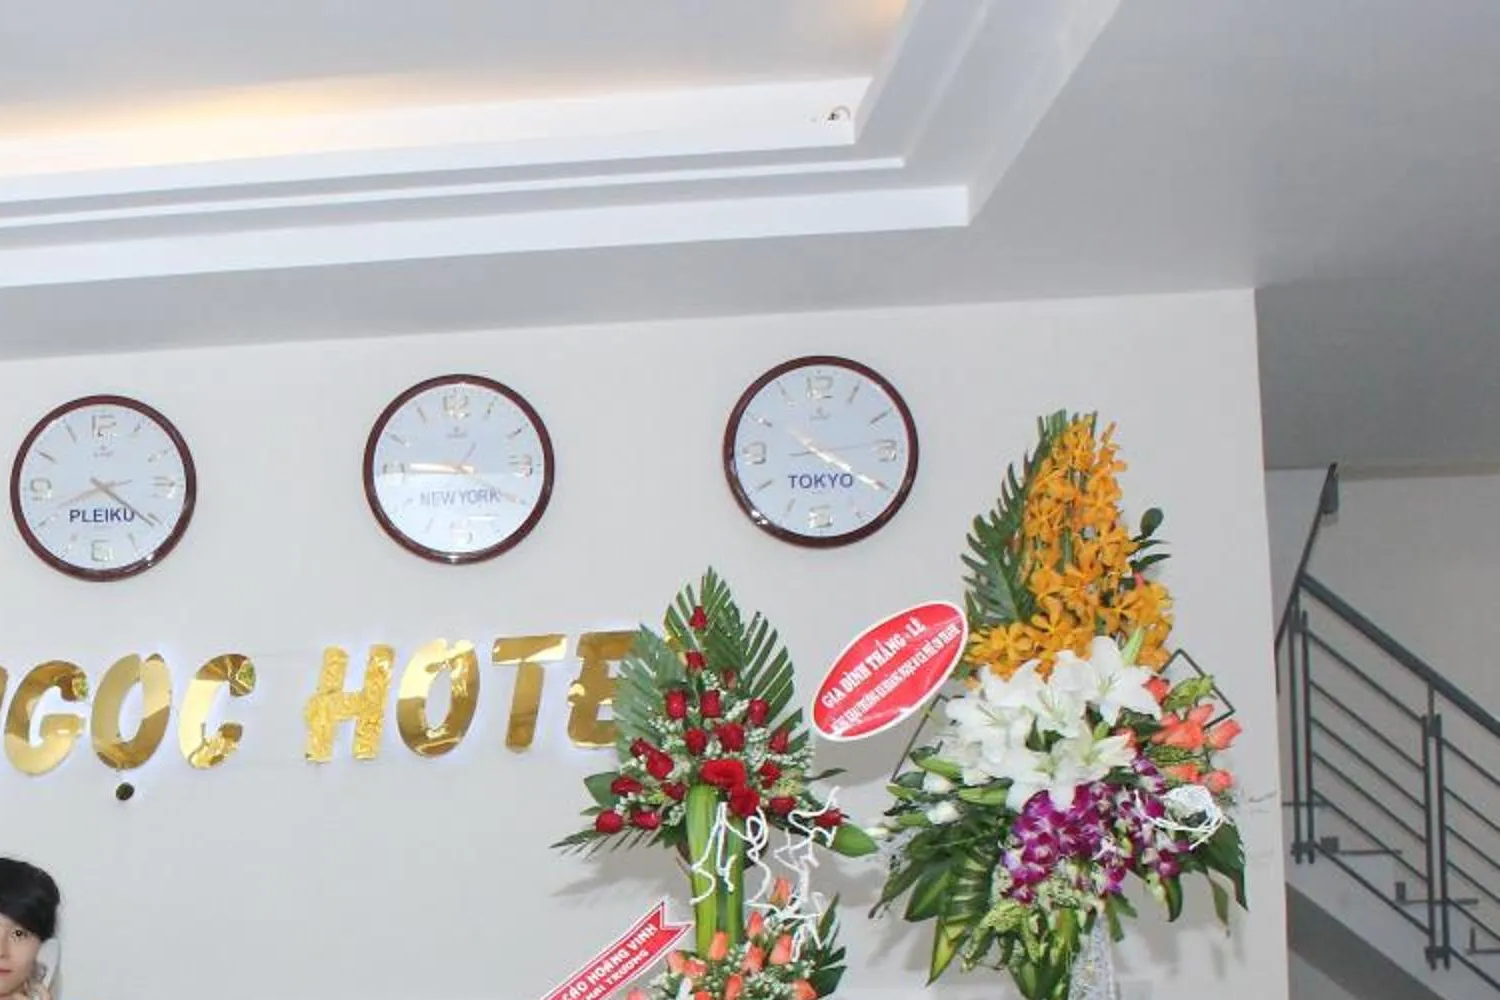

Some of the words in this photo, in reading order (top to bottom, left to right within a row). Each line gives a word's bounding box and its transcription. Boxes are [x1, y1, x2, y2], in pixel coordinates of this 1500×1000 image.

[788, 474, 853, 489] TOKYO
[420, 490, 458, 506] NEW
[461, 488, 500, 504] YORK
[69, 507, 135, 523] PLEIKU
[305, 630, 642, 766] HOTE
[822, 688, 846, 708] GIA
[625, 924, 657, 950] VINH
